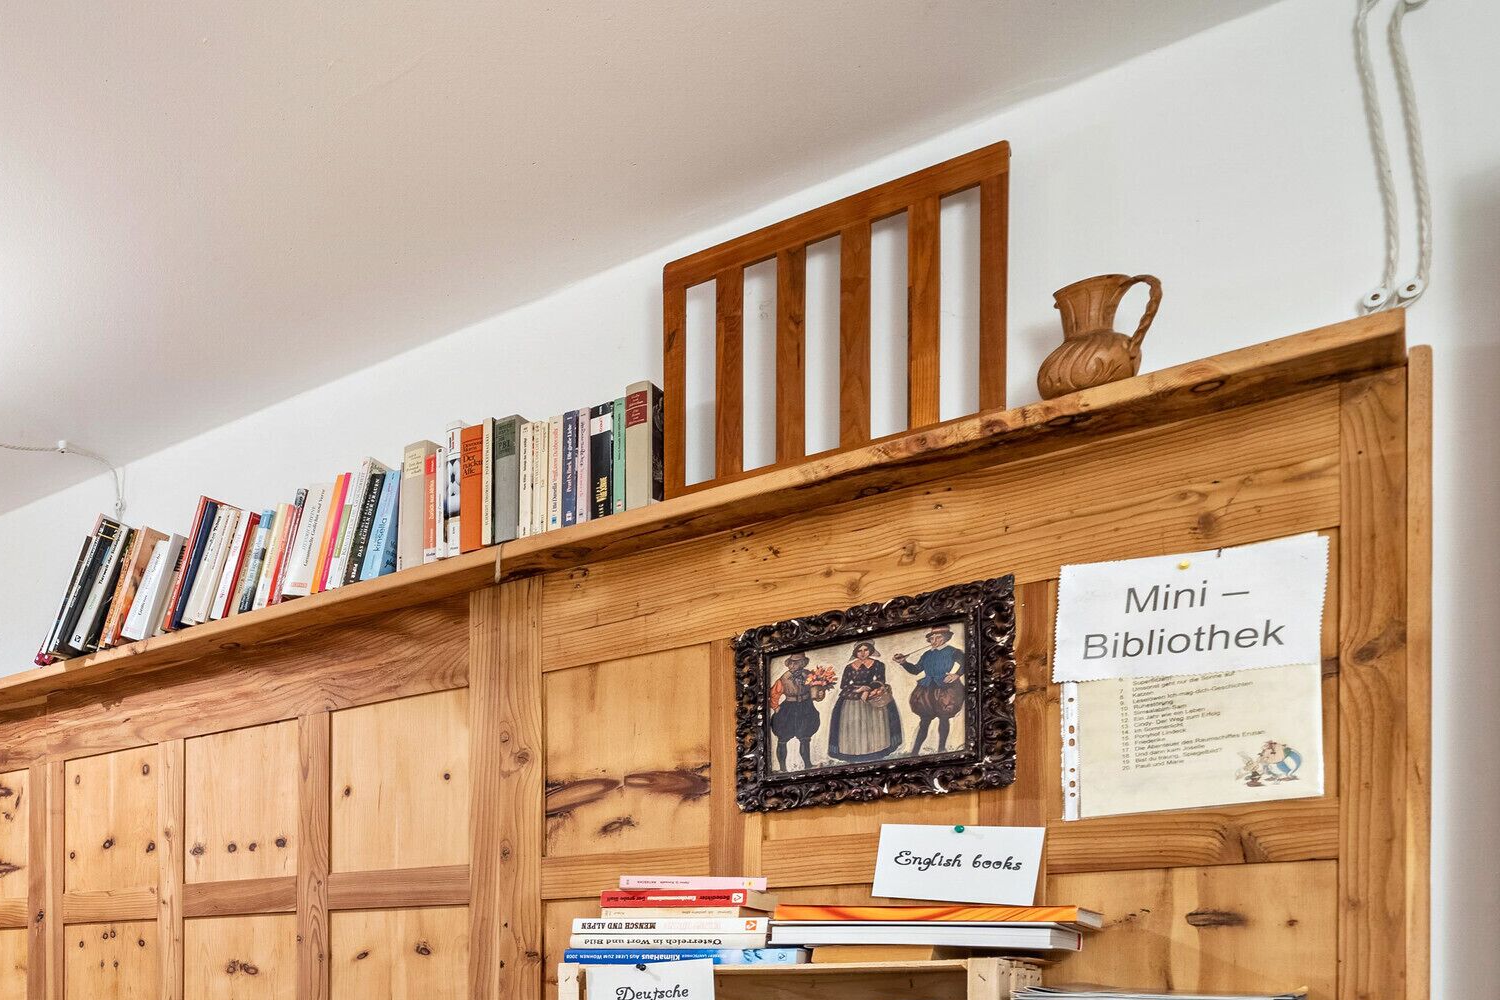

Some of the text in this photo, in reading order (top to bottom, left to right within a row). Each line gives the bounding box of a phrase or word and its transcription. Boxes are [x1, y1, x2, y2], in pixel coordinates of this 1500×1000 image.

[463, 468, 475, 476] Affe
[370, 477, 380, 502] FRAUEN
[372, 516, 387, 552] kinsella
[1125, 580, 1207, 613] Mini
[1083, 619, 1285, 660] Bibliothek
[1132, 690, 1153, 698] Katzen
[1134, 731, 1160, 739] Ponyhof
[1146, 741, 1179, 749] Abenteuer
[894, 851, 1022, 871] English books
